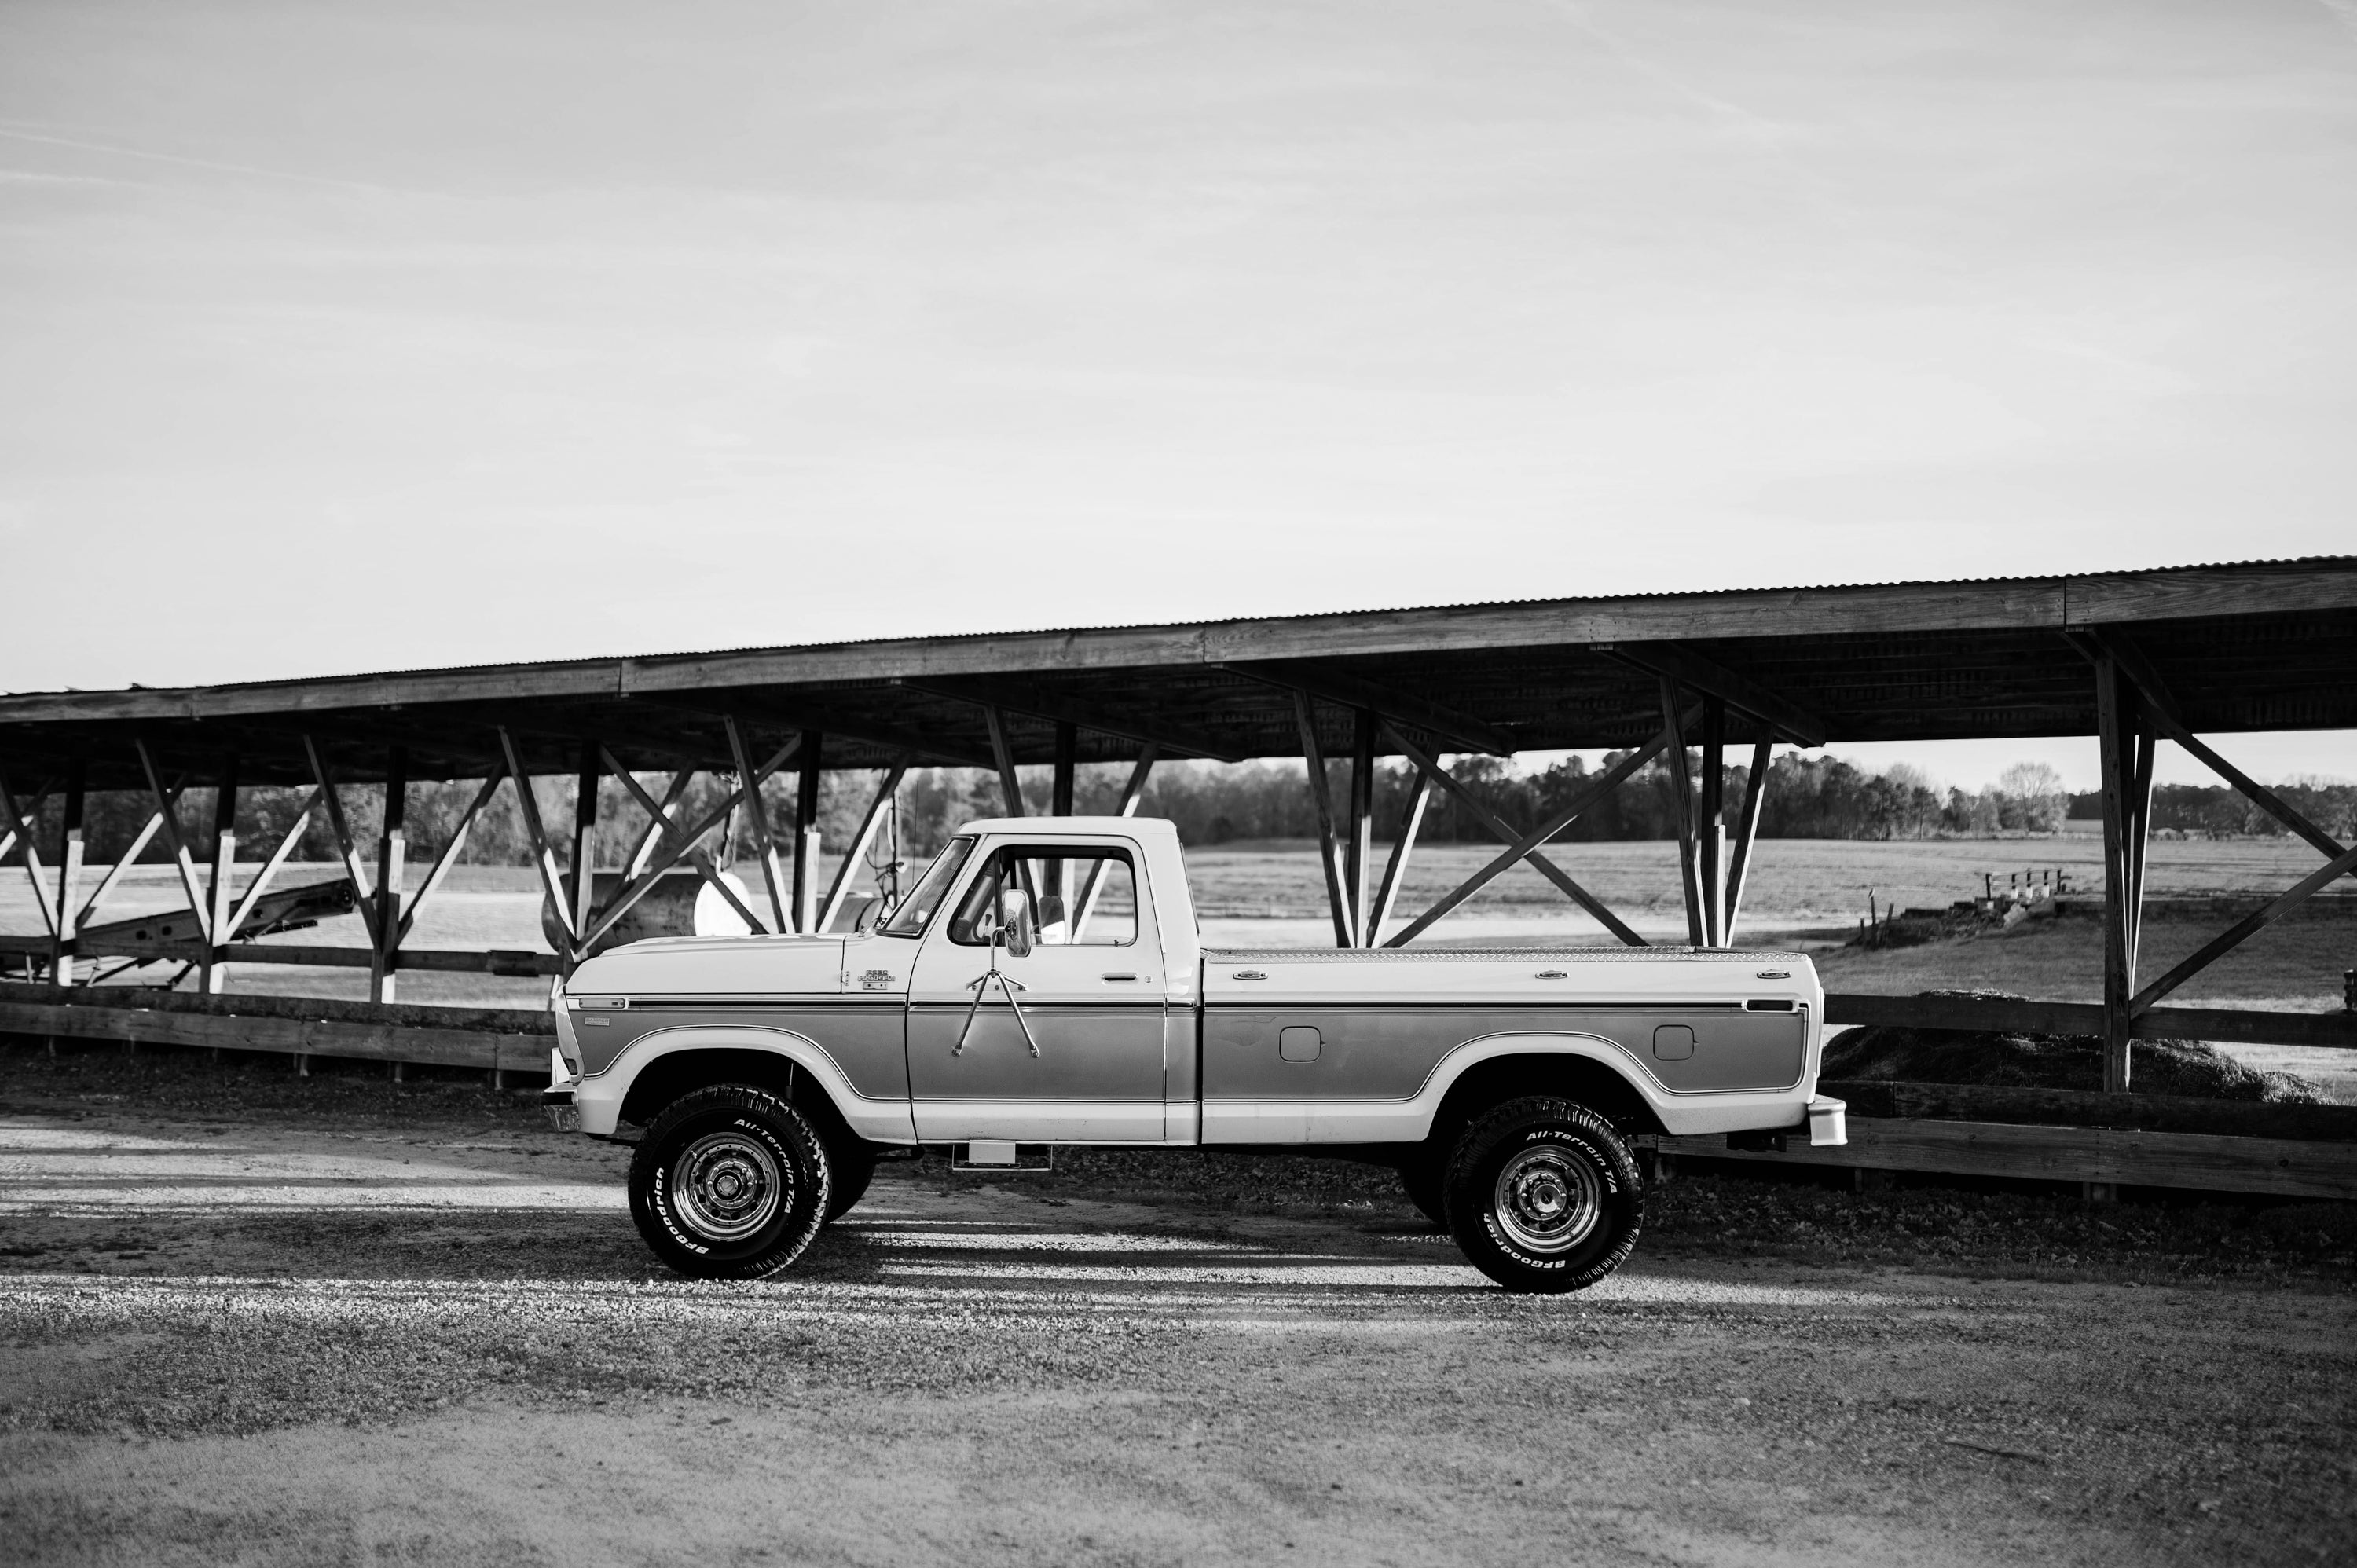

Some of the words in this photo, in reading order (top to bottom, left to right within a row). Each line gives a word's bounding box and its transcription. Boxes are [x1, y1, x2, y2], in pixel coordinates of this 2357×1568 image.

[733, 1119, 794, 1185] All-Terrain
[784, 1189, 795, 1214] T/A
[1526, 1130, 1606, 1167] All-Terrain
[1605, 1170, 1618, 1194] T/A
[654, 1167, 709, 1255] BFGoodrich
[1483, 1213, 1566, 1269] BFGoodrich
